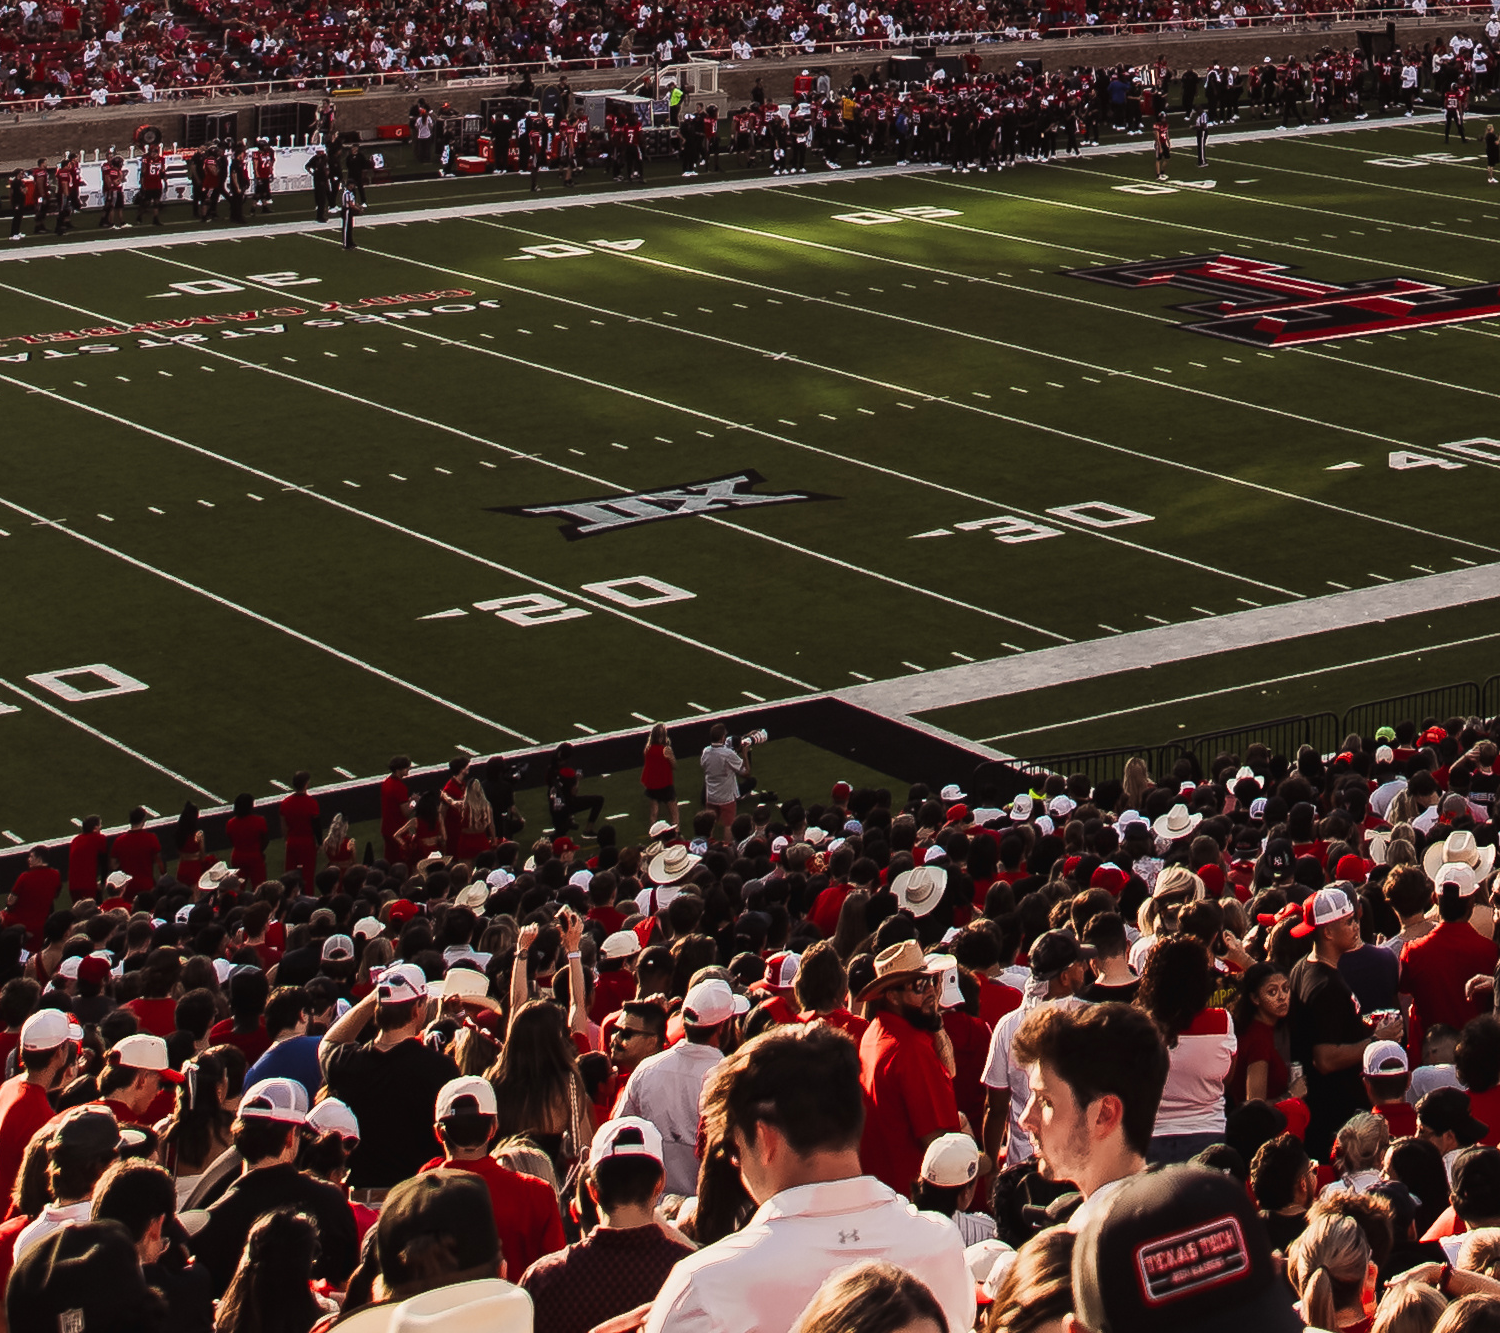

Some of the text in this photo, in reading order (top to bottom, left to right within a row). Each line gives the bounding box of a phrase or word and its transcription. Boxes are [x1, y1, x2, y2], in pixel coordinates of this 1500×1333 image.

[955, 500, 1156, 545] 30
[473, 575, 697, 627] 20
[1143, 1229, 1237, 1274] TEXAS TECH
